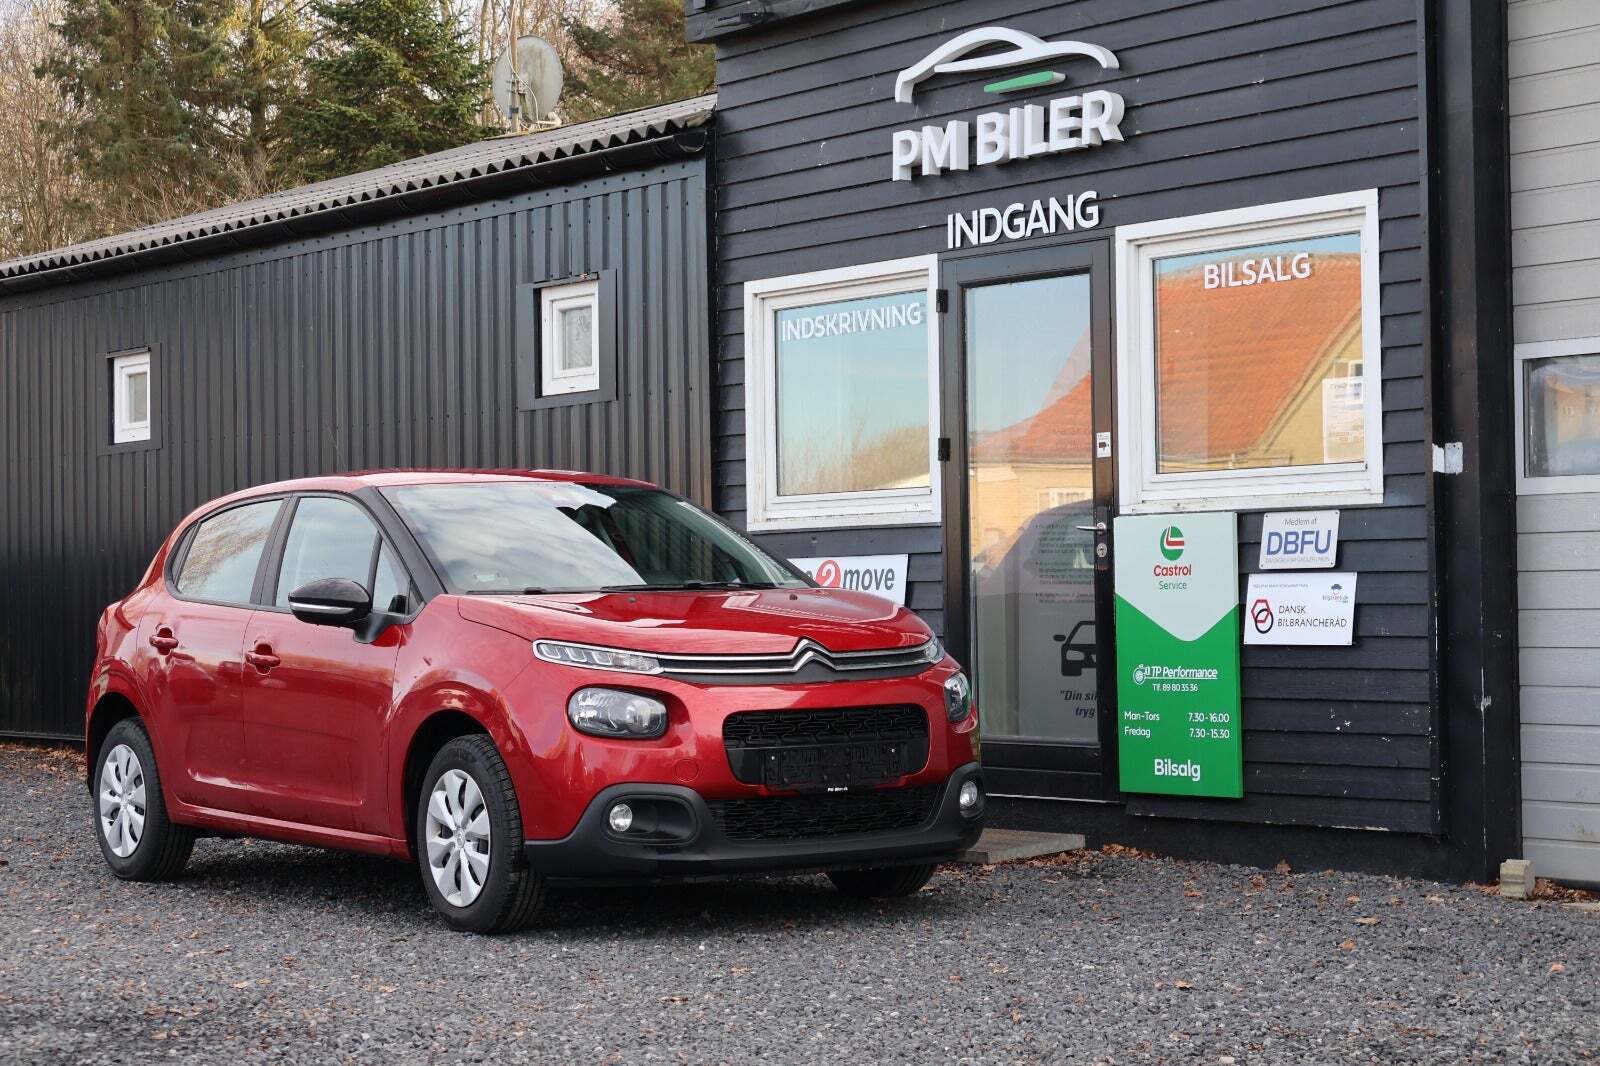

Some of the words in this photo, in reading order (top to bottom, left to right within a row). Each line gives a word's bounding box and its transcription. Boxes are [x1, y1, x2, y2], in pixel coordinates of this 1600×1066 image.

[892, 119, 969, 181] PM
[976, 89, 1125, 166] BILER
[947, 190, 1100, 249] INDGANG
[1203, 251, 1312, 290] BILSALG
[781, 301, 922, 342] INDSKRIVNING
[1284, 518, 1309, 526] Medlem
[1266, 529, 1332, 556] DBFU
[1153, 563, 1192, 577] Castrol
[1158, 580, 1188, 590] Service
[1278, 605, 1306, 614] DANSK
[1277, 615, 1348, 628] BILBRANCHERÅD
[1151, 665, 1162, 678] TP
[1162, 665, 1218, 678] Performance
[1124, 711, 1160, 721] Man-Tors
[1187, 712, 1204, 722] 7.30
[1209, 712, 1230, 723] 16.00
[1124, 726, 1151, 738] Fredag
[1189, 727, 1206, 738] 7.30
[1210, 728, 1230, 739] 15.30
[1153, 758, 1201, 782] Bilsalg
